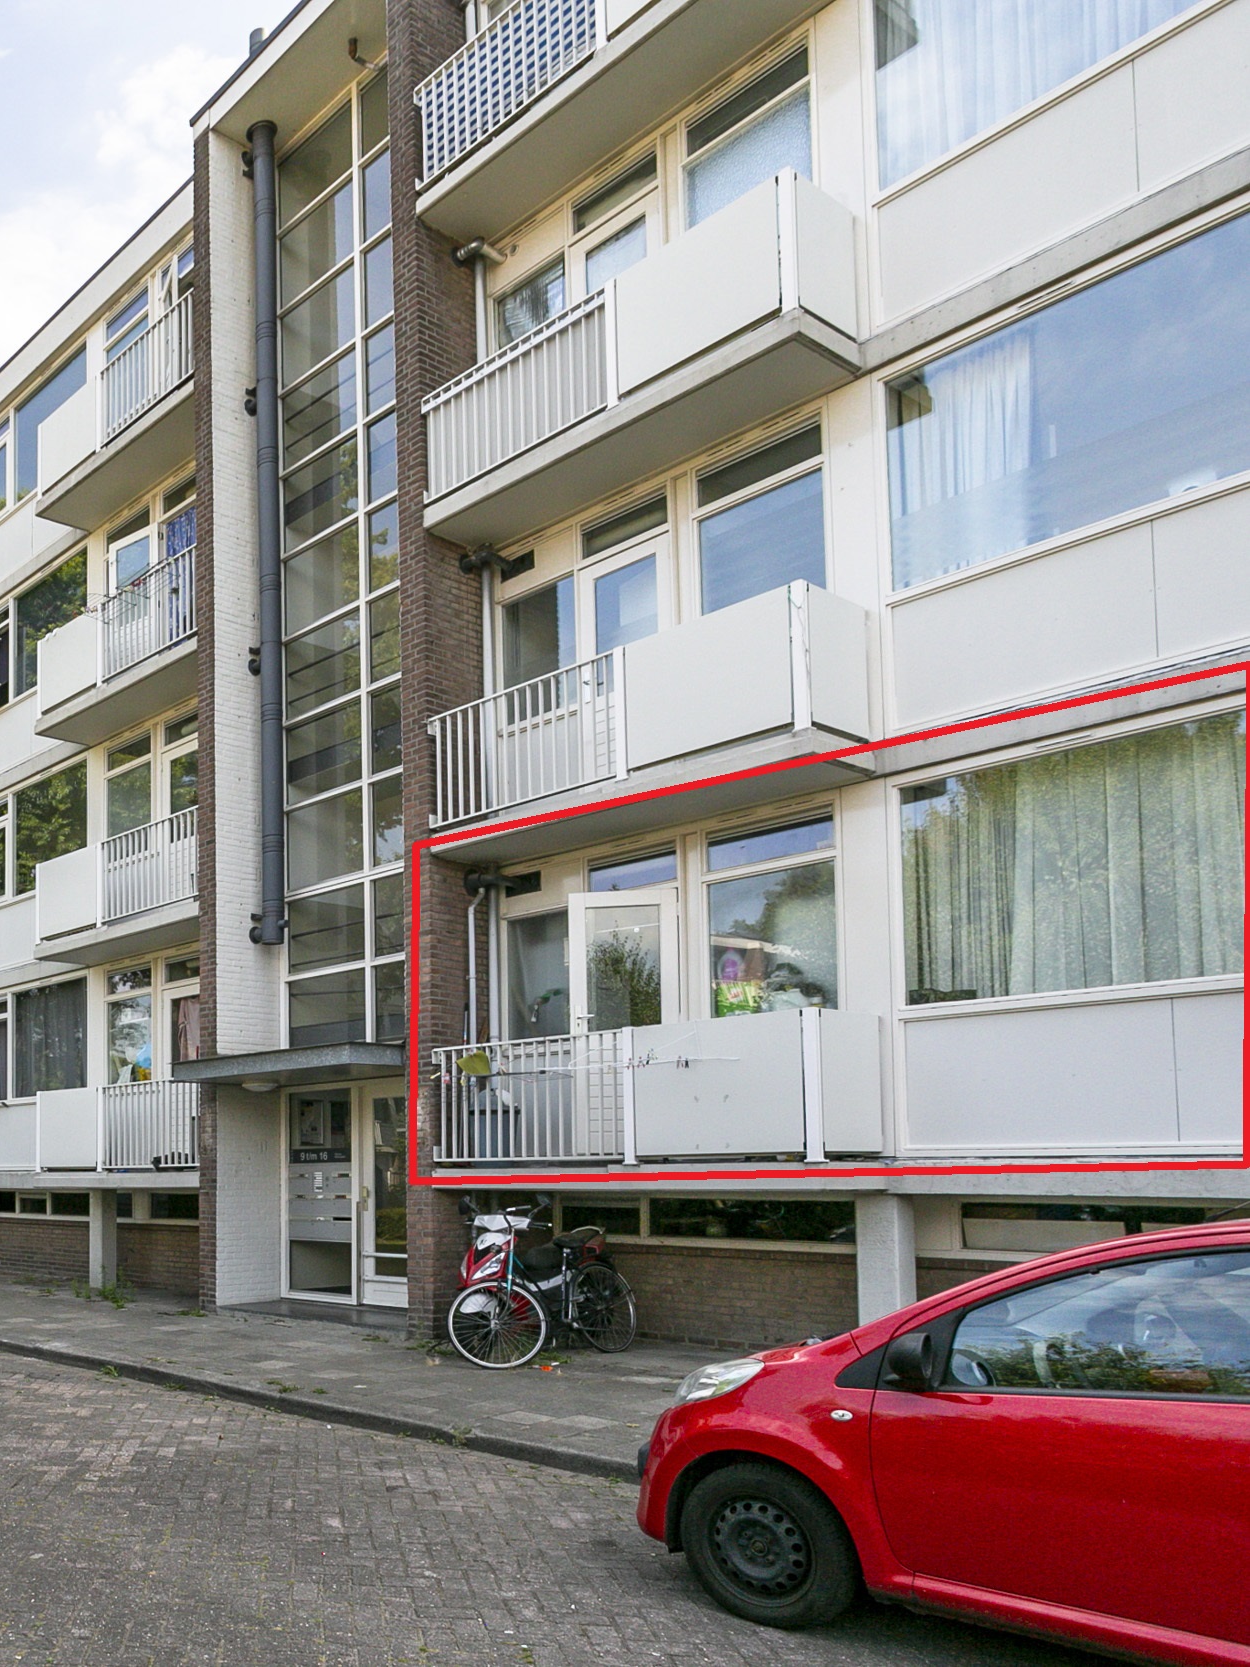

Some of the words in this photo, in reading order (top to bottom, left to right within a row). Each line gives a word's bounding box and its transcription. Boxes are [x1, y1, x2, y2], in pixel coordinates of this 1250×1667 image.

[300, 1152, 305, 1161] 9
[306, 1152, 318, 1161] t/m
[319, 1151, 328, 1161] 16
